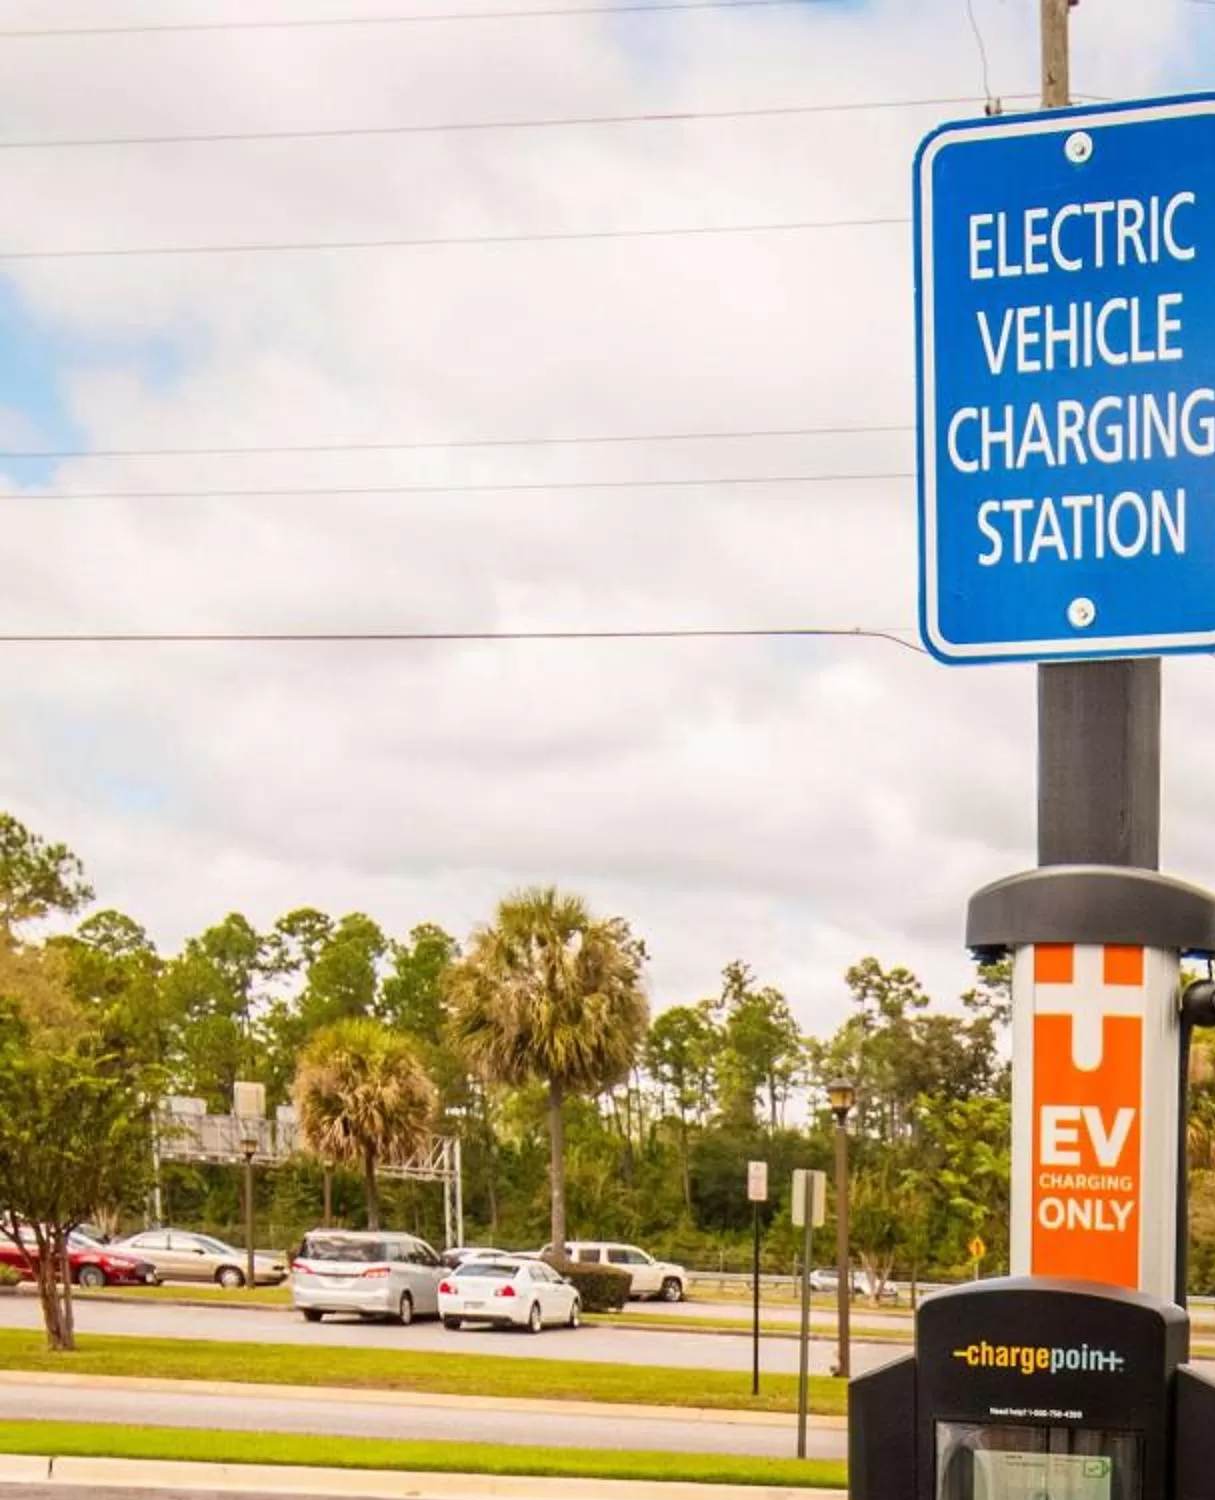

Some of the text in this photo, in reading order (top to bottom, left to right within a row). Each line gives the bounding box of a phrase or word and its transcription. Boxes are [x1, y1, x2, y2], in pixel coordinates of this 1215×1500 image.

[969, 191, 1196, 280] ELECTRIC
[976, 293, 1184, 375] VEHICLE
[977, 488, 1186, 566] STATION
[1040, 1104, 1136, 1167] EV
[1038, 1197, 1134, 1232] ONLY
[1039, 1172, 1132, 1191] CHARGING
